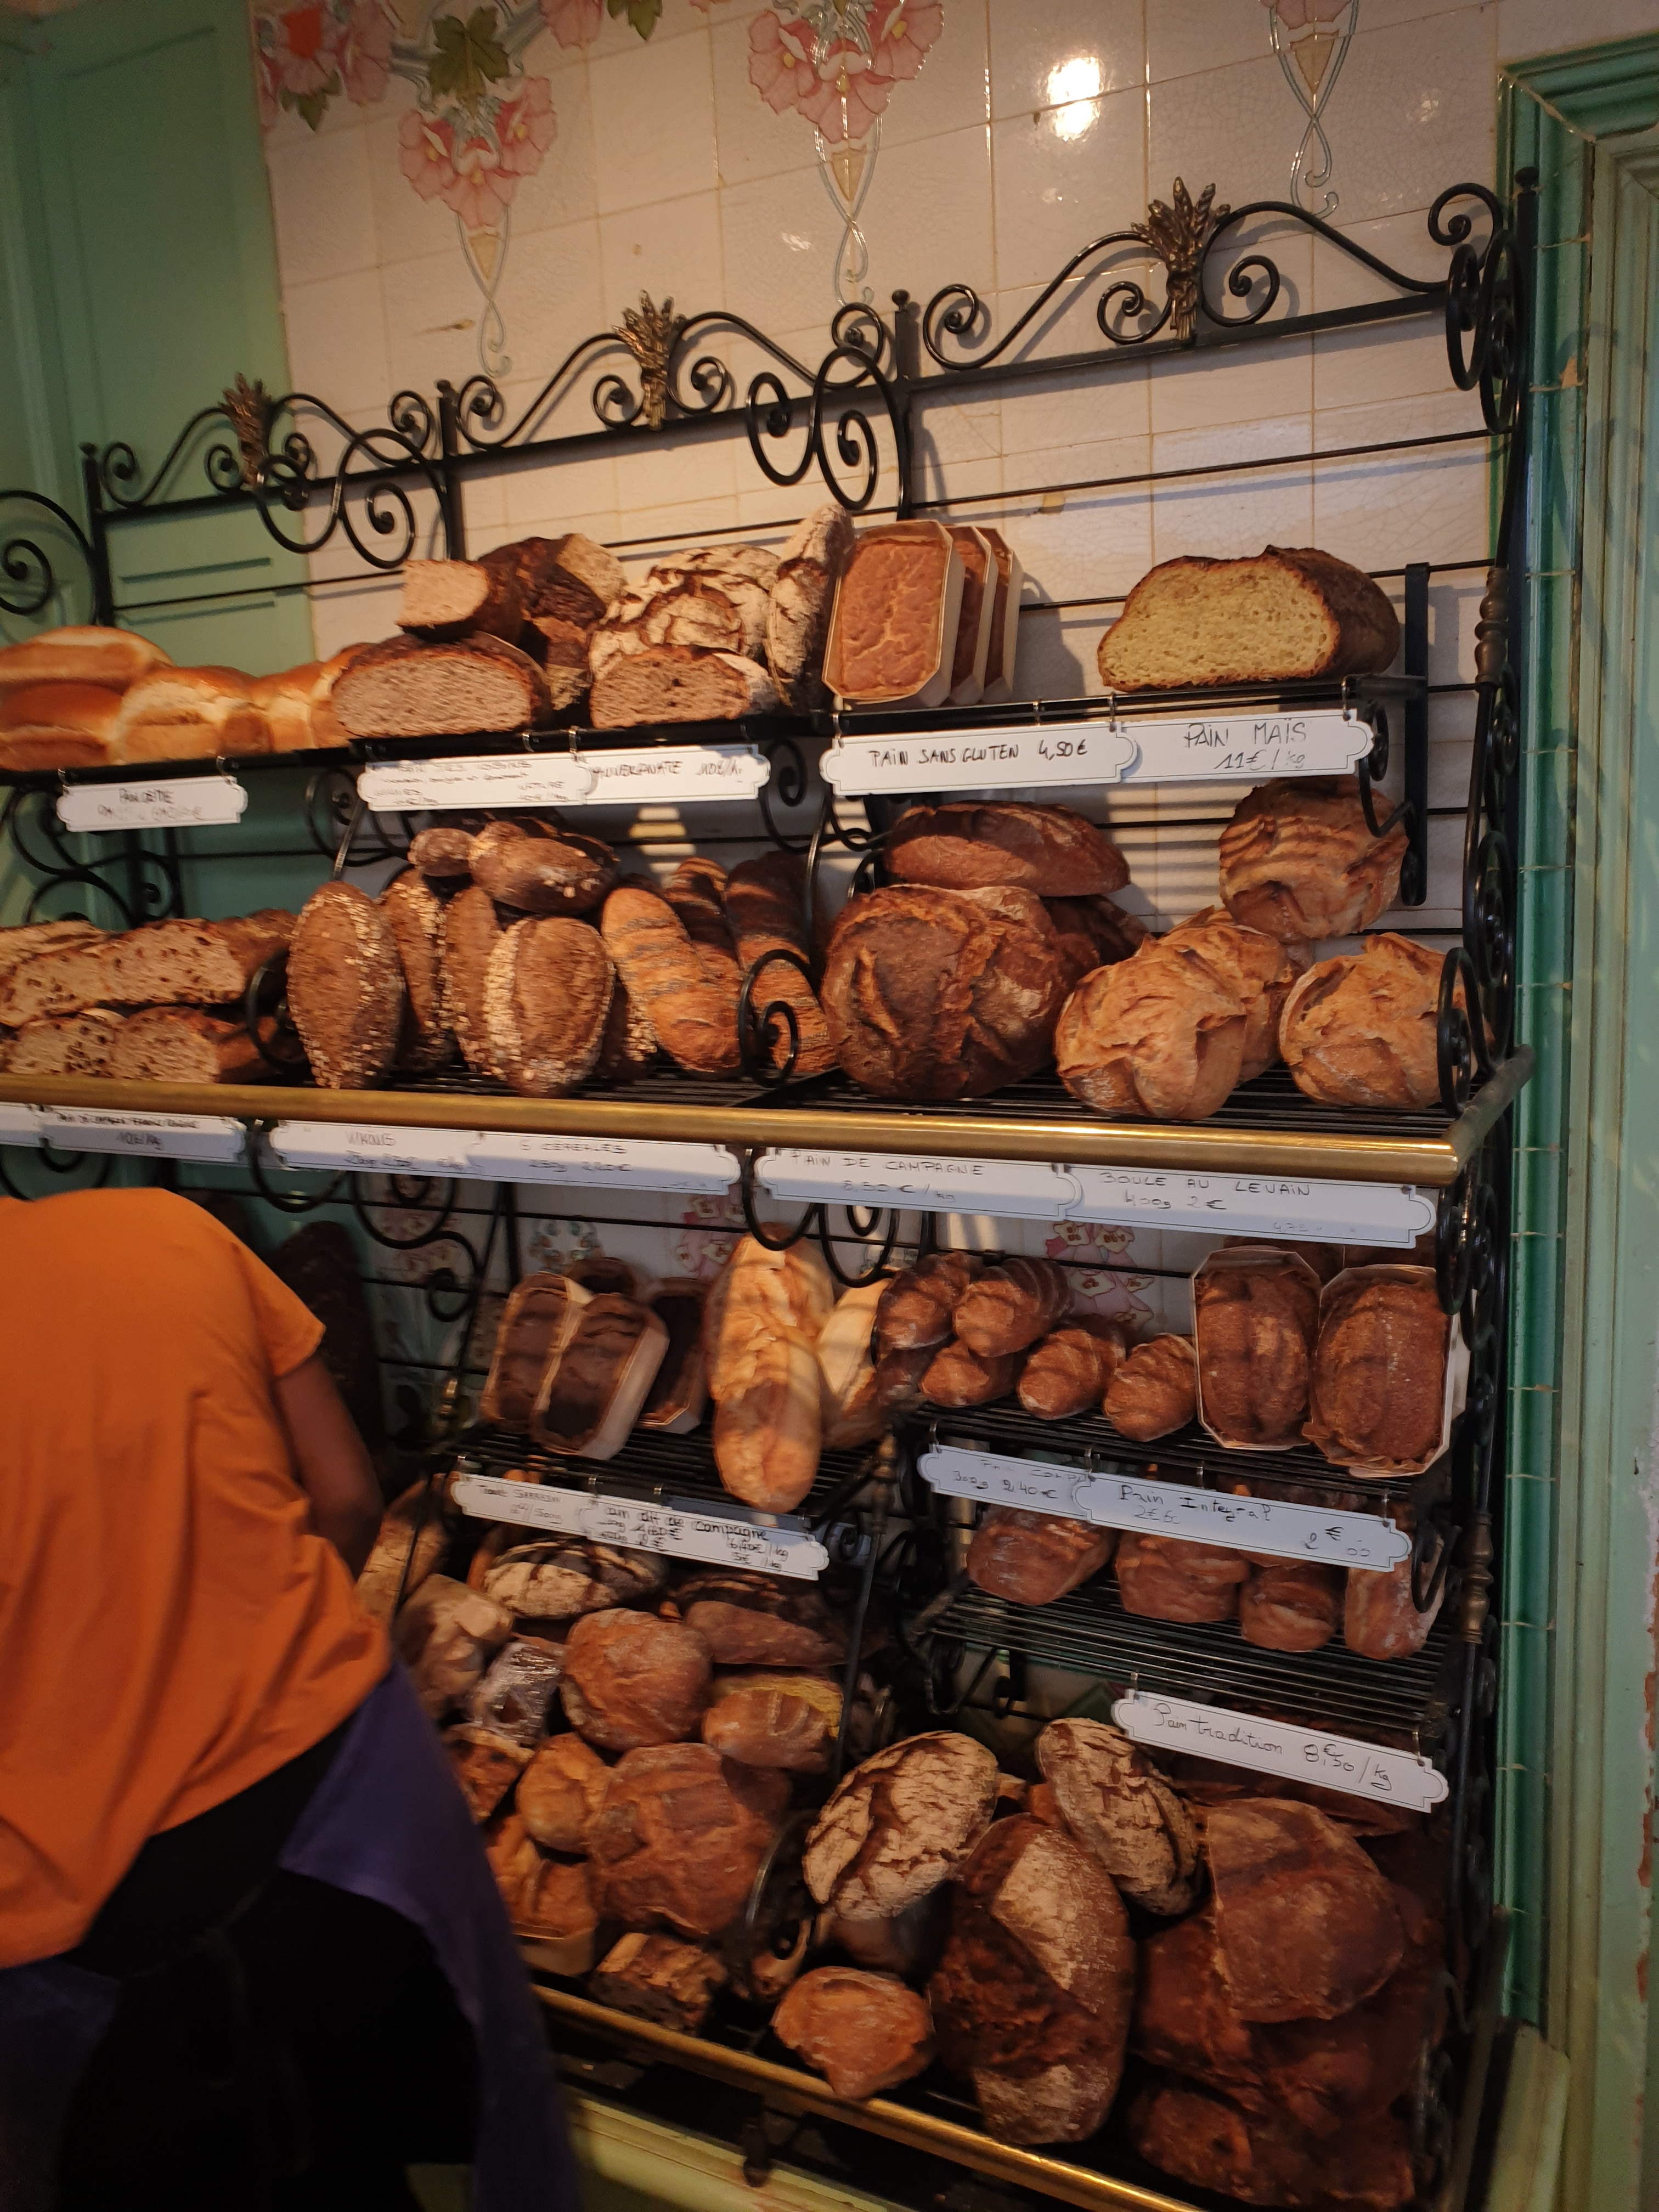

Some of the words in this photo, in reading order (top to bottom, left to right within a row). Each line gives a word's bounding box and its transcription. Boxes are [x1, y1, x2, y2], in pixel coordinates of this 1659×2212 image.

[1183, 723, 1229, 748] PAIN
[869, 750, 909, 768] PAIN
[918, 748, 957, 764] SANS
[962, 744, 1019, 761] GLUTEN
[1038, 738, 1088, 761] 4,50€
[791, 1150, 831, 1167] PAIN
[842, 1158, 871, 1169] DE
[885, 1161, 985, 1176] CAMPAGNE
[1099, 1172, 1167, 1186] BOULE
[1188, 1178, 1210, 1189] AU
[1234, 1181, 1311, 1196] LEVAIN
[1119, 1484, 1164, 1505] Pain
[1153, 1702, 1187, 1731] Pain
[1189, 1716, 1283, 1755] tradition
